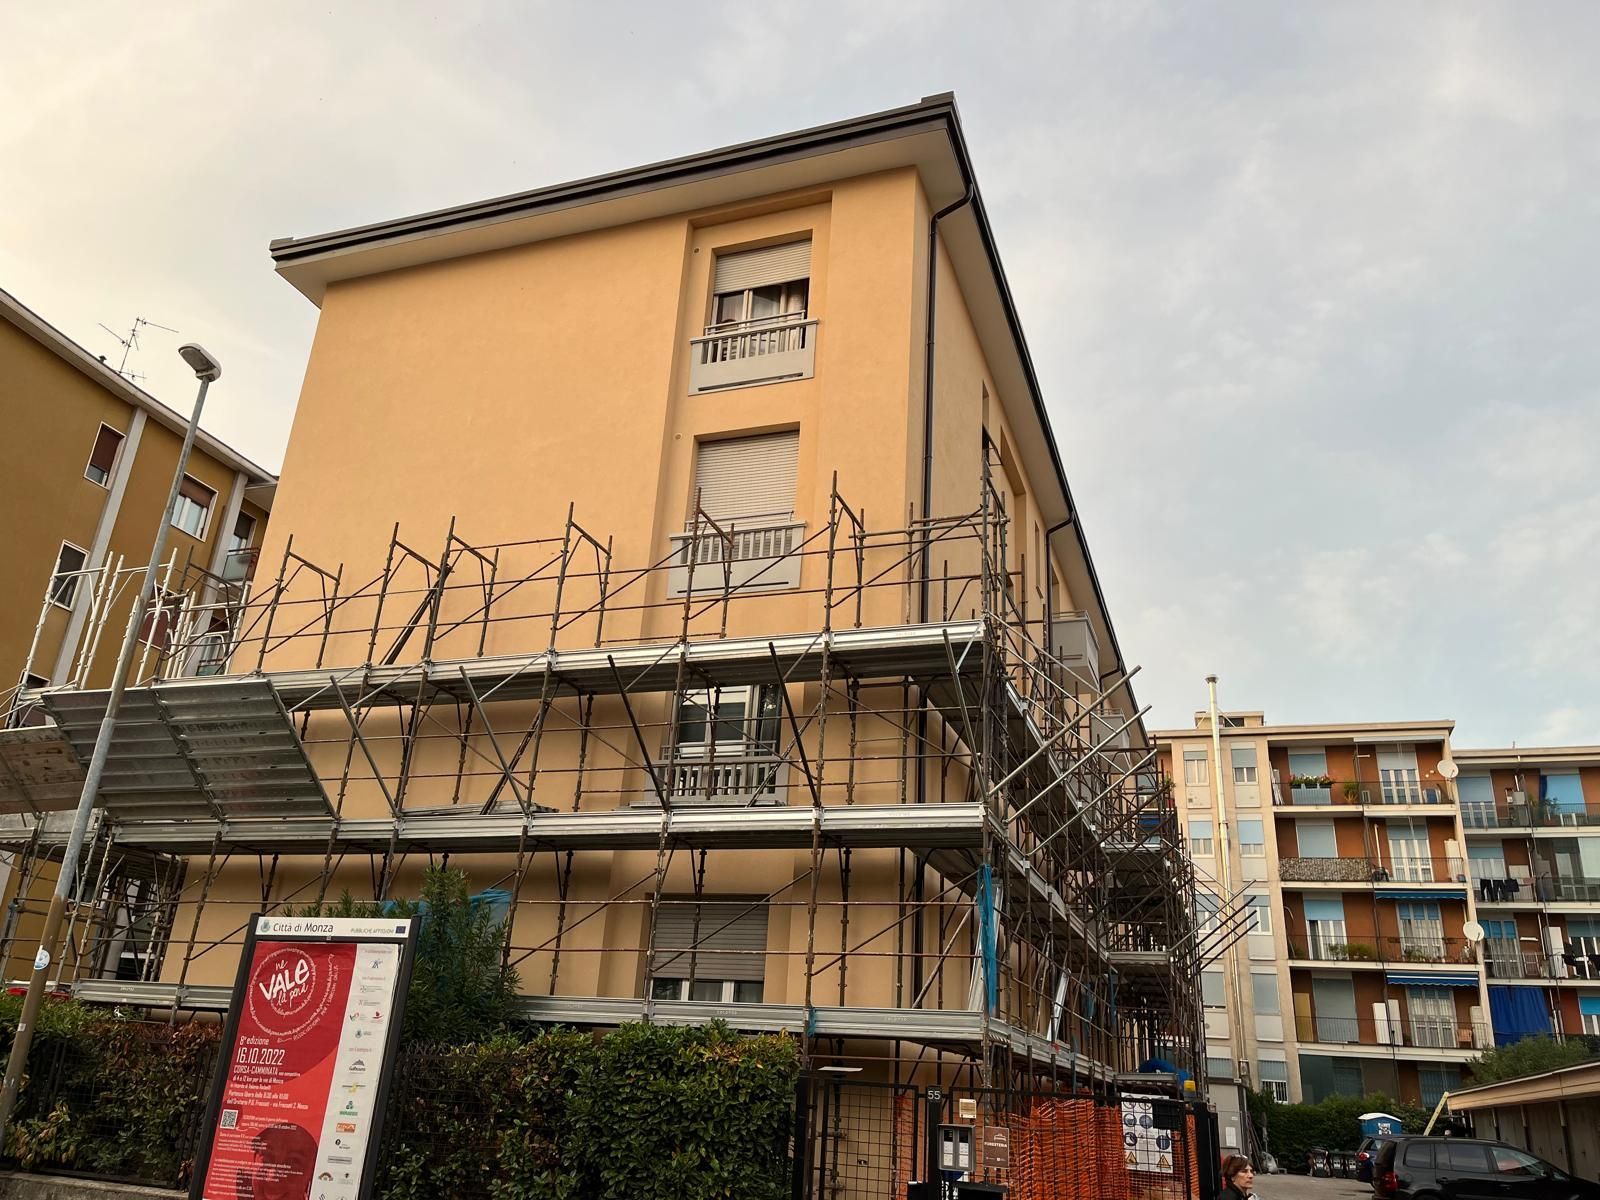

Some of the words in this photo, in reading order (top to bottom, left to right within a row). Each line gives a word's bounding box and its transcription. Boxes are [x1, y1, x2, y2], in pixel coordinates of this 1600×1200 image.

[273, 922, 292, 932] Città
[294, 922, 302, 932] di
[304, 923, 334, 932] Monza
[246, 1036, 270, 1046] edizione
[236, 1048, 286, 1066] 16.10.2022
[928, 1090, 941, 1100] 55
